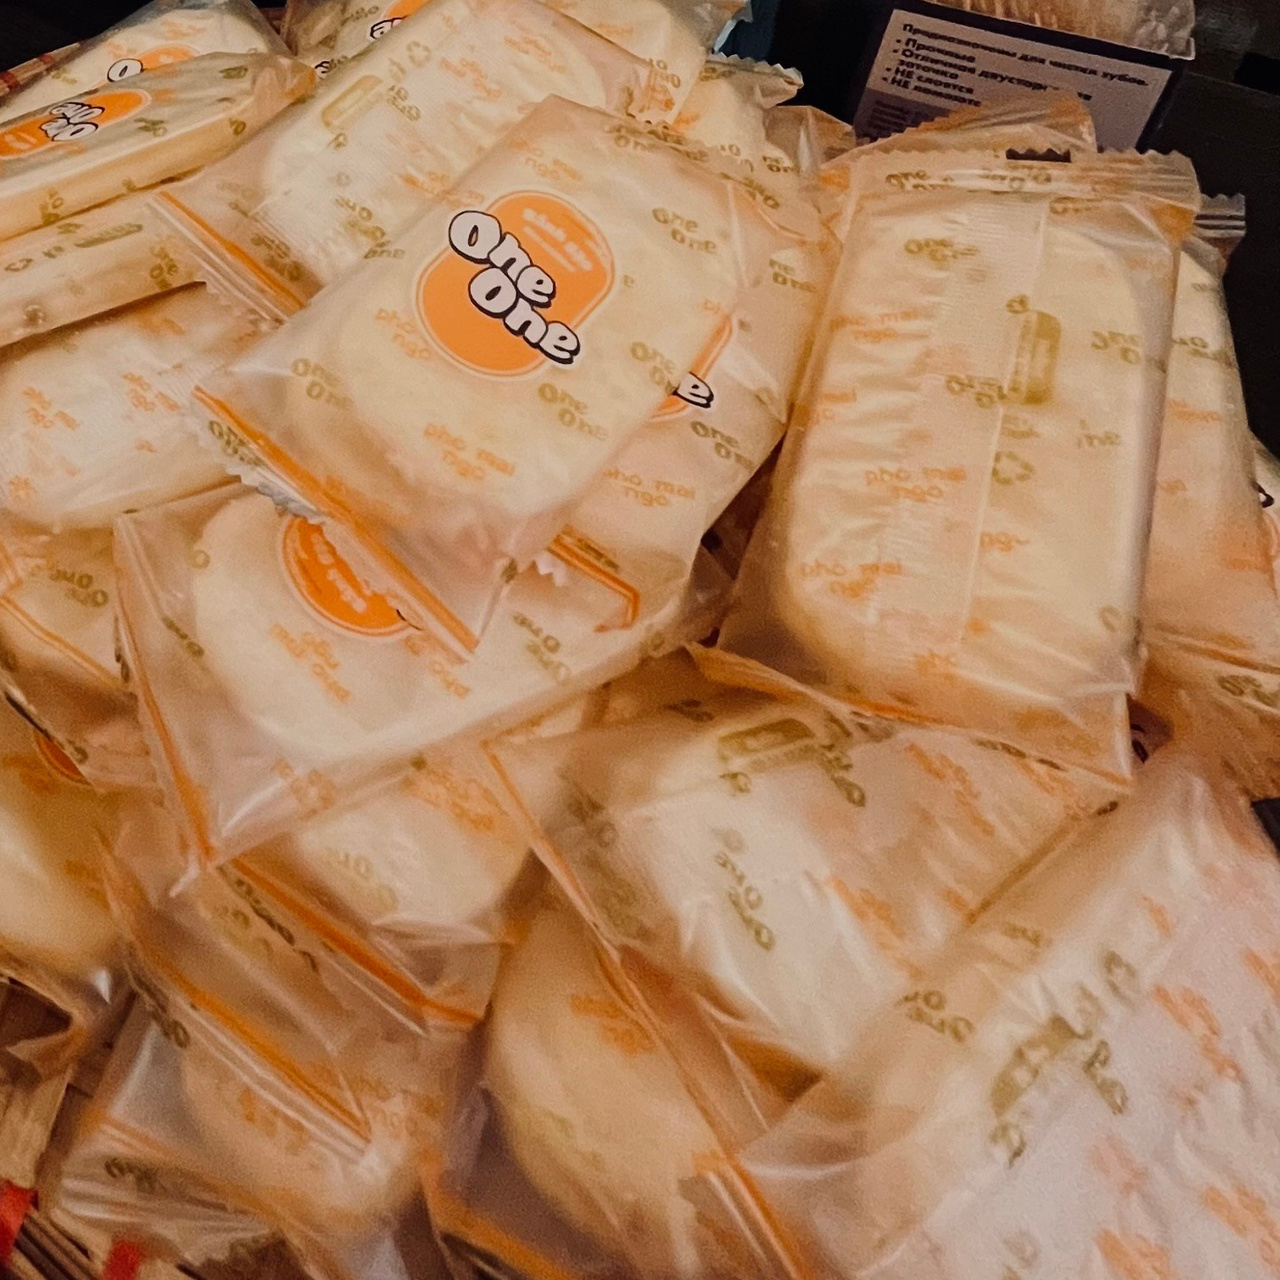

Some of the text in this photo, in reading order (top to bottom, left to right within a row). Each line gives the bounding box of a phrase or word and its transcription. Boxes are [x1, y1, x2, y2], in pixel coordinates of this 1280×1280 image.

[890, 76, 910, 90] НЕ
[894, 67, 914, 81] НЕ
[448, 209, 556, 308] One
[468, 266, 581, 365] One
